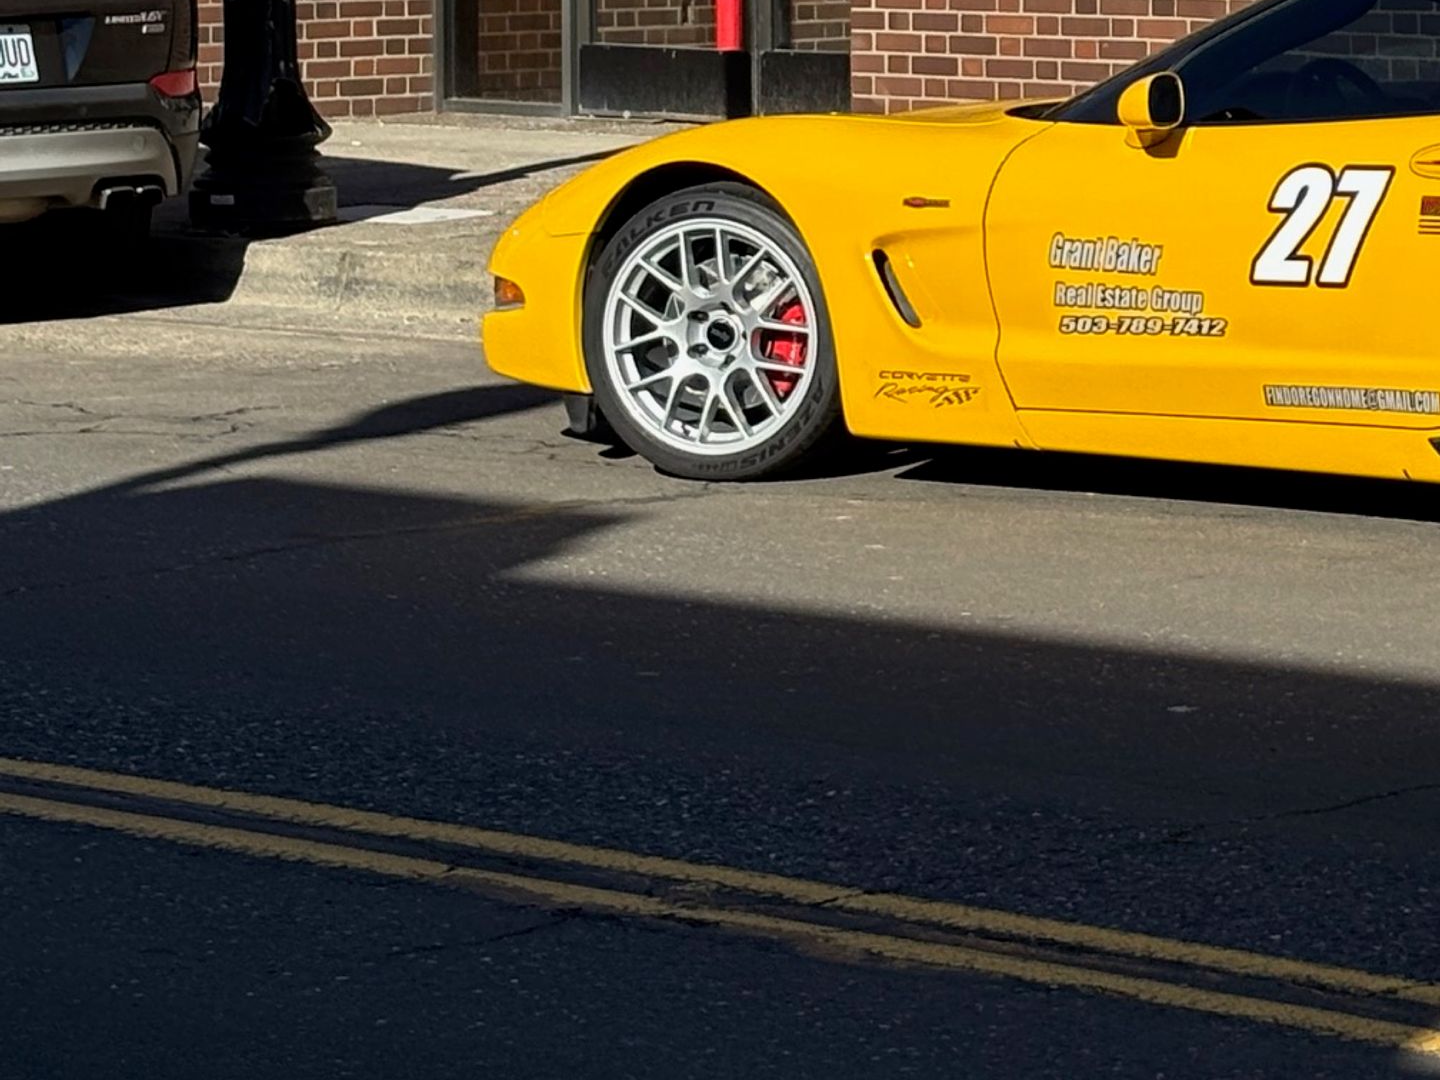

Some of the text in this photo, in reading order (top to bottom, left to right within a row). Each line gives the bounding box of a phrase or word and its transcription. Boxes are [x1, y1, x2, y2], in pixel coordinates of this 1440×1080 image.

[601, 201, 715, 277] FALKEN
[1250, 162, 1395, 288] 27
[1049, 232, 1163, 275] Grant Baker
[1054, 281, 1203, 316] Real Estate Group
[1059, 315, 1227, 337] 503-789-7412
[878, 370, 971, 382] CORVETTE
